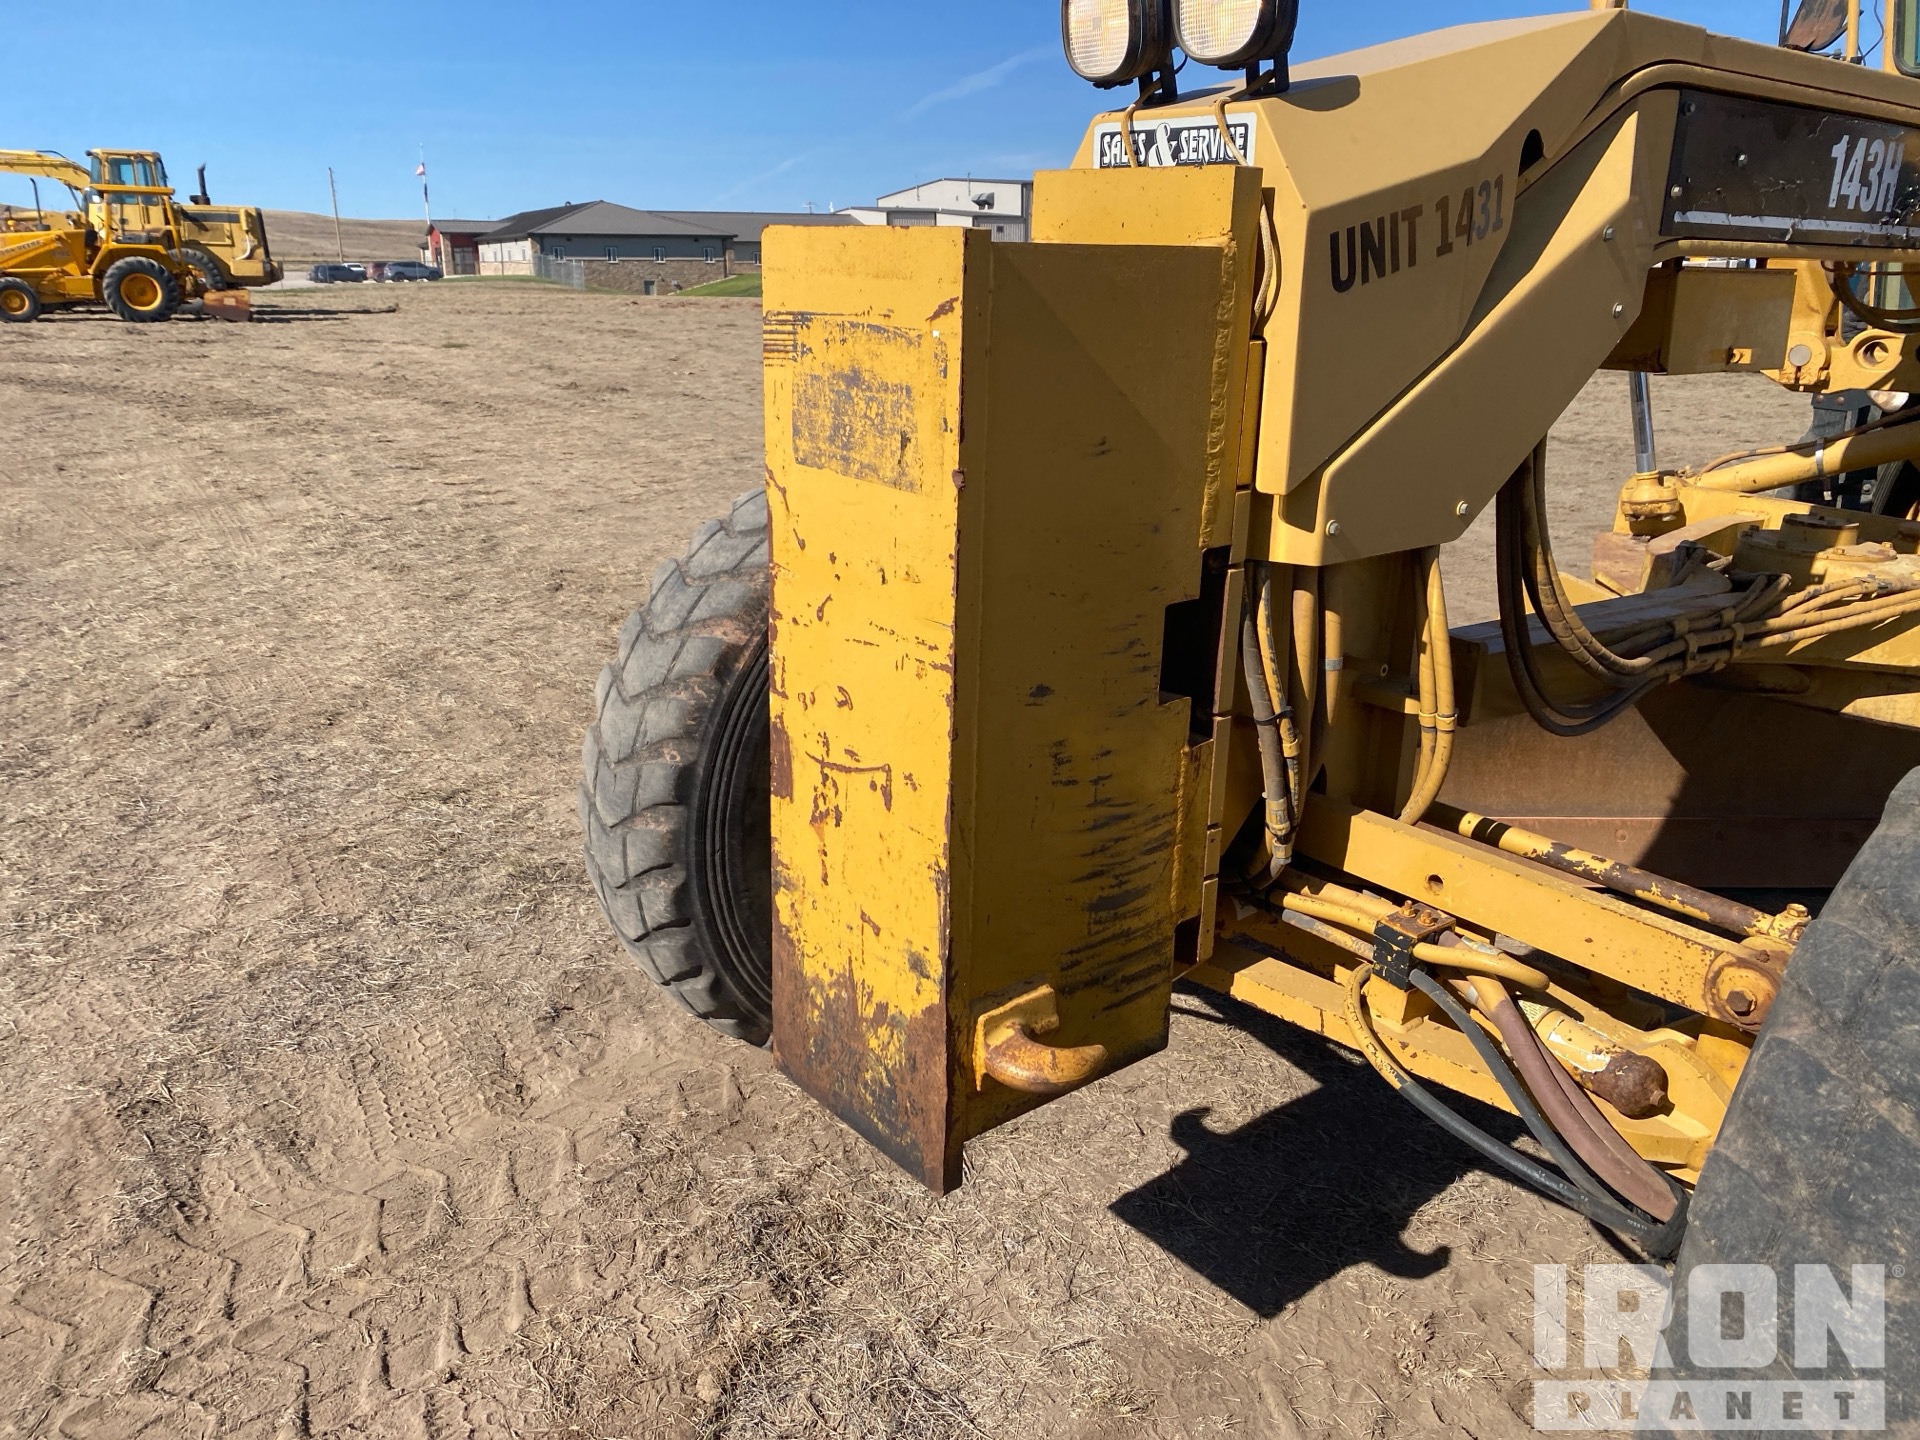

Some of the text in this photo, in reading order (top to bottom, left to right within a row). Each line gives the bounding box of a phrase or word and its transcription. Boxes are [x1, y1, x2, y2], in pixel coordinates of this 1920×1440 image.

[1147, 122, 1178, 167] &
[1828, 134, 1905, 213] 143H
[1329, 173, 1504, 294] UNIT 1431
